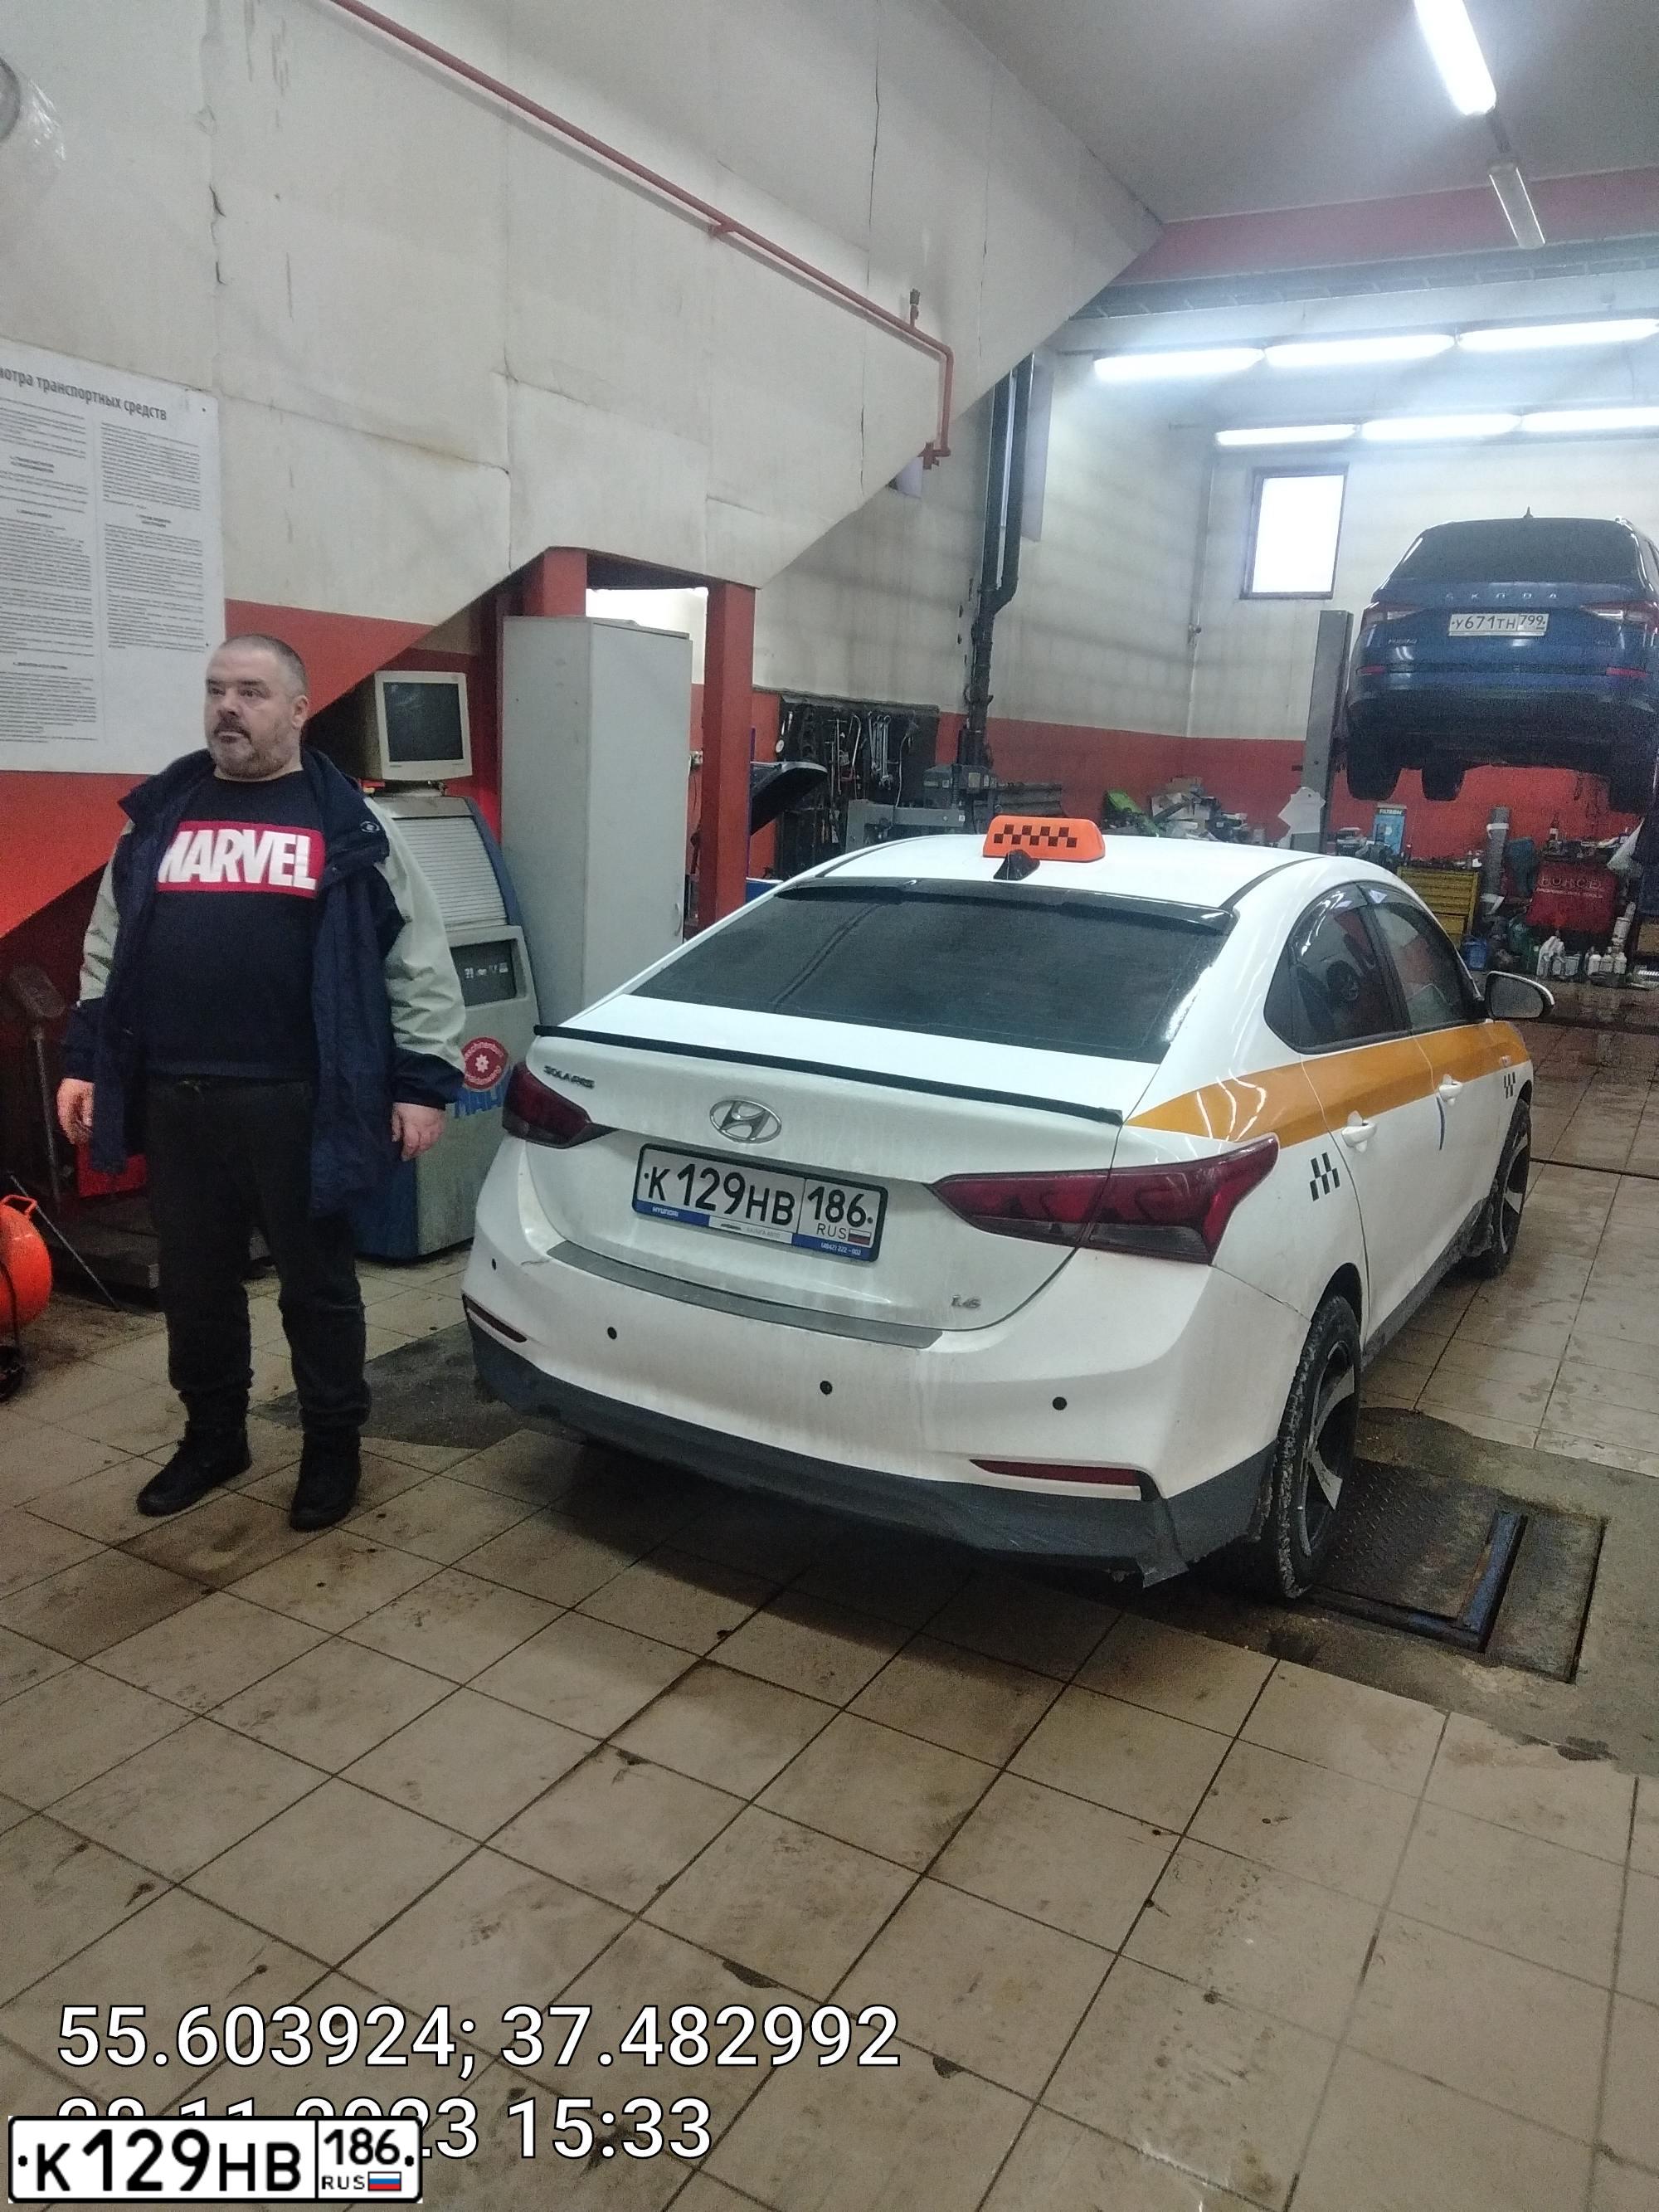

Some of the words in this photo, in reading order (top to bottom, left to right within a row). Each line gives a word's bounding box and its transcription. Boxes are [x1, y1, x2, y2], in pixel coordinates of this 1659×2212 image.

[36, 376, 122, 409] транспортных
[124, 401, 168, 421] средств
[1520, 615, 1545, 626] 799
[158, 828, 317, 891] MARVEL
[543, 1065, 596, 1089] SOLARIS
[807, 1186, 867, 1228] 186
[816, 1222, 847, 1240] RUS
